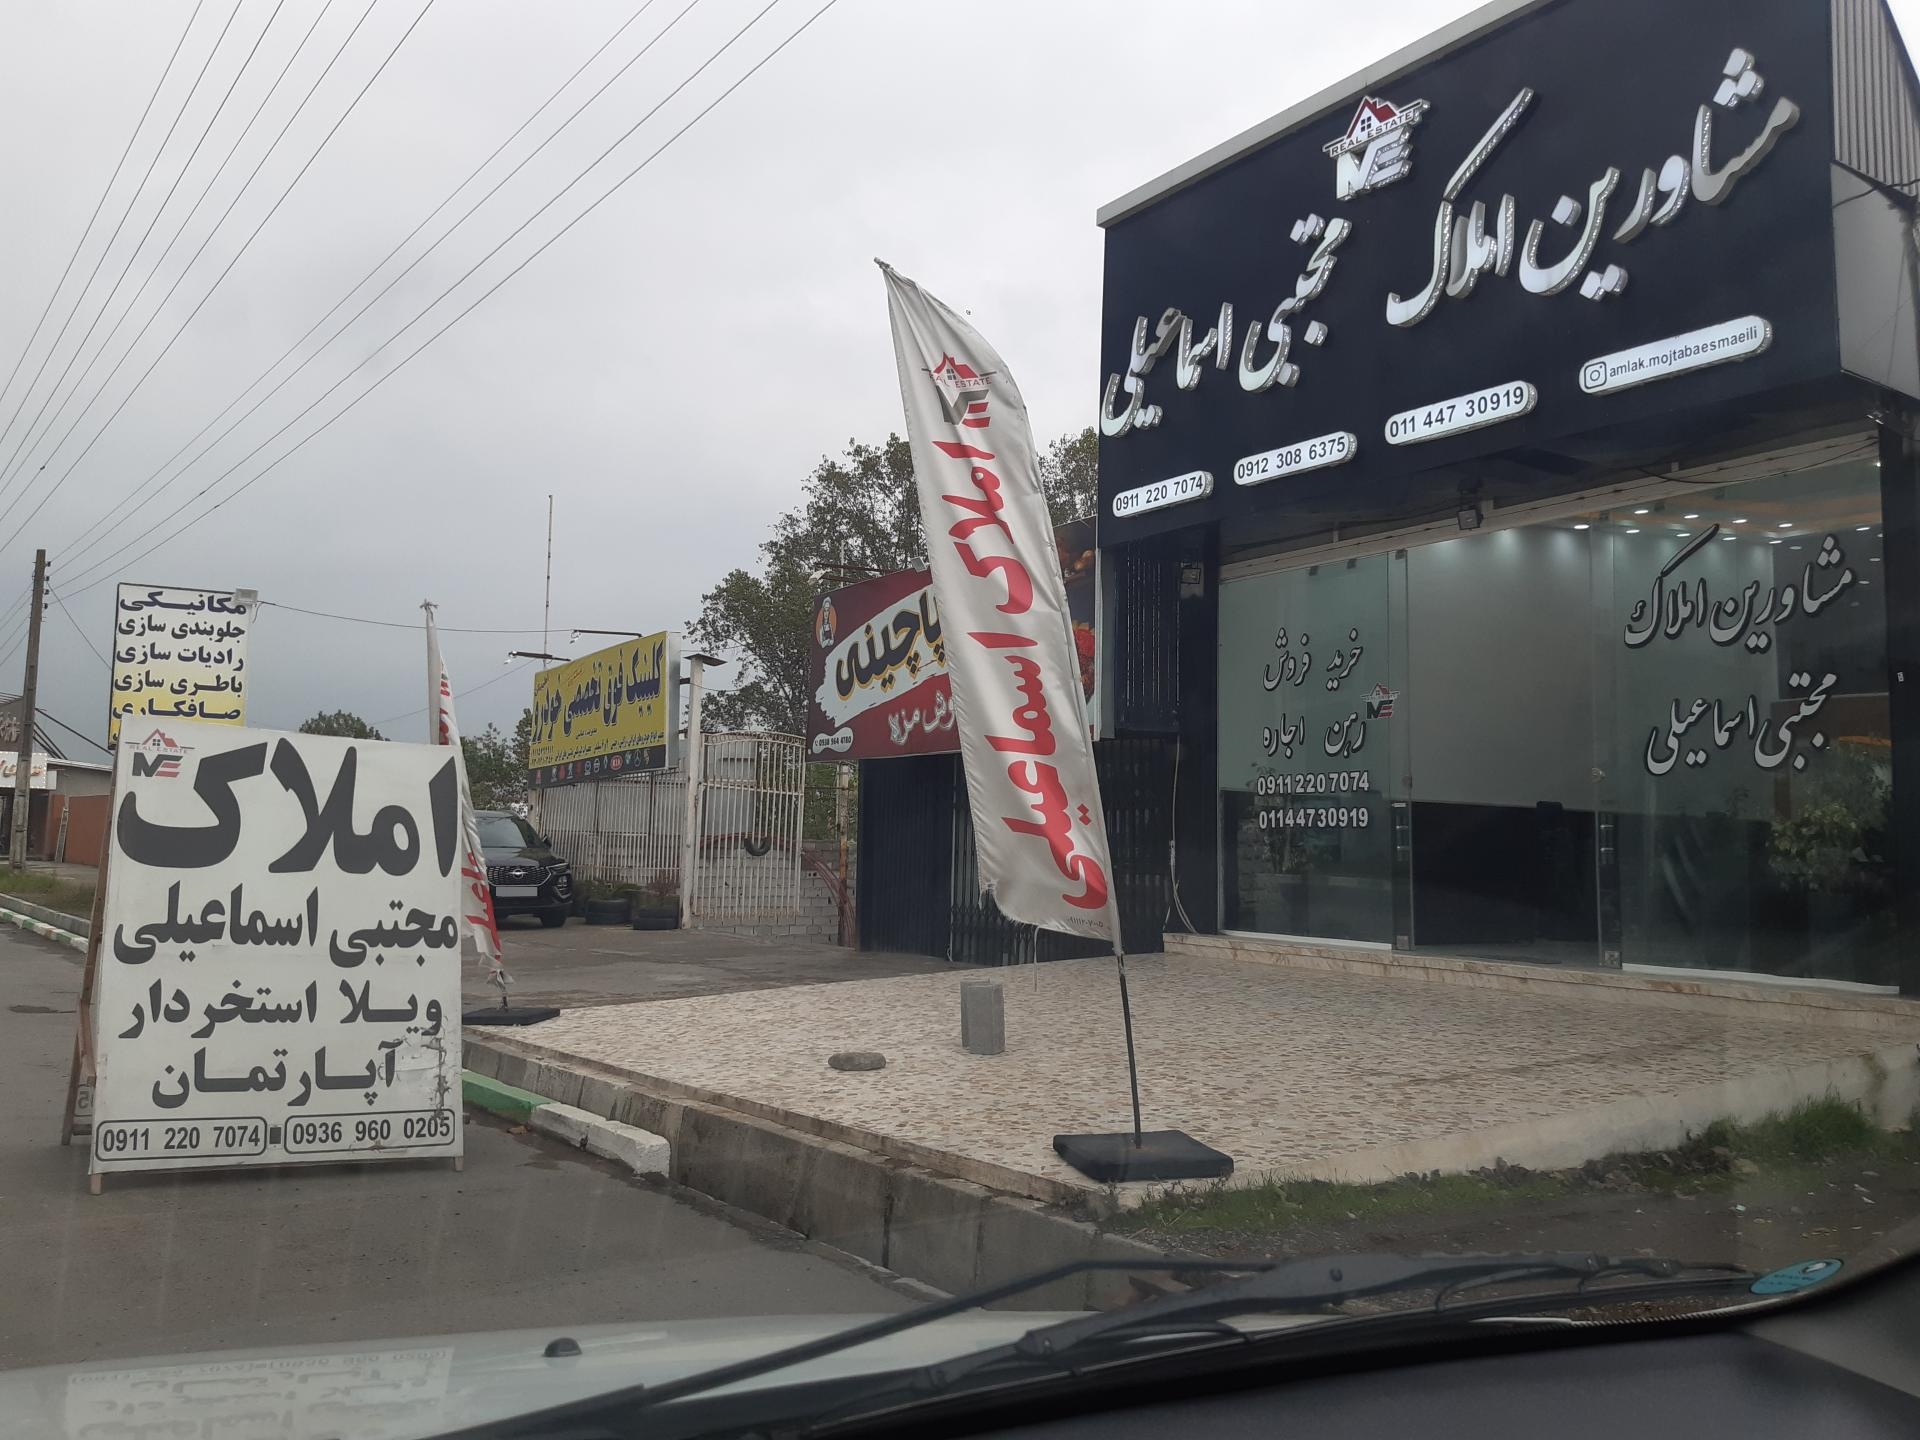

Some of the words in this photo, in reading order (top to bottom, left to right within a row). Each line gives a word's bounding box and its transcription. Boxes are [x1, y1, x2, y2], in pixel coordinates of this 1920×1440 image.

[1331, 136, 1362, 156] REAL
[1367, 109, 1413, 138] ESTATE
[1519, 48, 1800, 302] مشاورین
[1386, 86, 1535, 328] املاک
[1239, 212, 1353, 393] مجتبی
[1100, 301, 1235, 438] اسماعیلی
[1609, 325, 1758, 378] amlak.mojtabaesmaeili
[954, 376, 993, 389] ESTATE
[1389, 415, 1416, 438] 011
[1422, 405, 1457, 429] 447
[1464, 386, 1525, 418] 30919
[1237, 456, 1270, 480] 0912
[1275, 448, 1302, 470] 308
[1308, 435, 1347, 461] 6375
[1115, 492, 1140, 512] 0911
[1145, 484, 1168, 504] 220
[1173, 474, 1204, 497] 7074
[931, 440, 1035, 615] املاک
[119, 590, 247, 616] مکانیکی
[1622, 523, 1720, 648] املاک
[1708, 532, 1854, 654] مشاورین
[116, 641, 172, 665] سازی
[118, 613, 167, 637] سازی
[170, 619, 246, 644] جلوبندی
[113, 668, 165, 693] سازی
[169, 673, 243, 698] باطری
[177, 644, 245, 672] رادیات
[625, 639, 664, 718] کلینیک
[1262, 627, 1312, 692] فروش
[1326, 627, 1364, 691] خرید
[1262, 713, 1305, 759] اجاره
[1324, 711, 1367, 758] رهن
[1645, 694, 1758, 776] اسماعیلی
[1753, 671, 1838, 771] مجتبی
[966, 631, 1109, 911] اسماعیلی
[115, 737, 460, 878] املاک
[113, 880, 319, 965] اسماعیلی
[329, 899, 459, 969] مجتبی
[340, 978, 443, 1037] ویلا
[150, 1040, 403, 1109] آپارتمان
[102, 1127, 151, 1153] 0911
[163, 1126, 201, 1150] 220
[213, 1124, 261, 1149] 7074
[292, 1121, 344, 1146] 0936
[354, 1118, 392, 1143] 960
[403, 1115, 451, 1140] 0205
